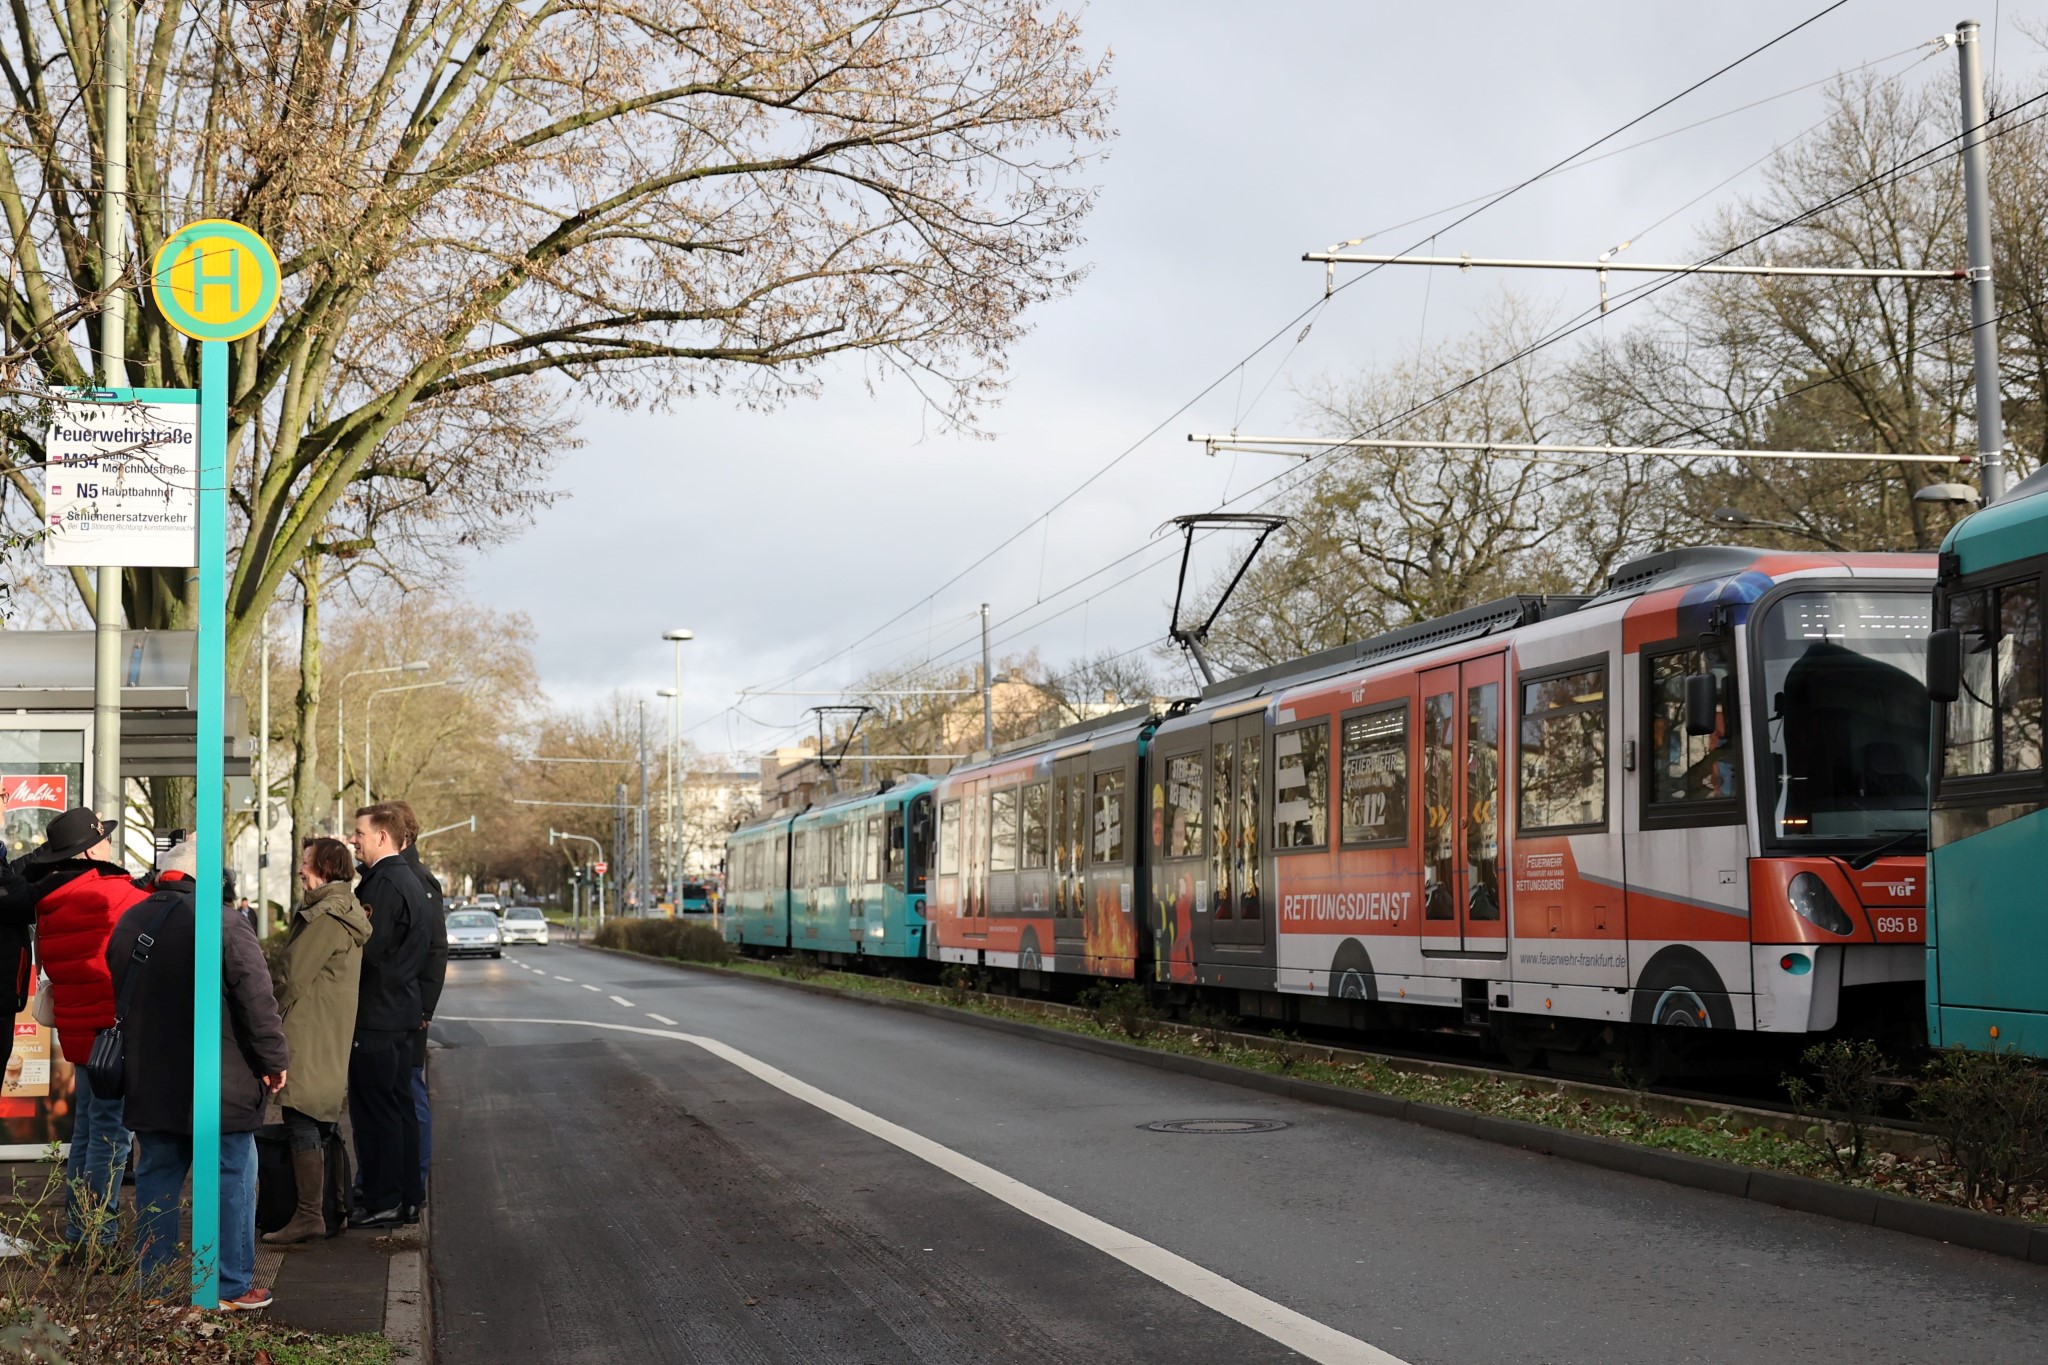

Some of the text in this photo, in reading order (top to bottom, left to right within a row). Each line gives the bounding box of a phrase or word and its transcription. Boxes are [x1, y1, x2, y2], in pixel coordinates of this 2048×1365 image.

[193, 248, 240, 312] H
[53, 426, 192, 444] Feuerwehrstraße
[63, 453, 99, 469] M34
[102, 463, 186, 474] Möchhofstraße
[76, 483, 98, 499] N5
[102, 486, 174, 498] Hauptbahnhof
[67, 510, 188, 523] Schienenersatzverkehr
[116, 523, 142, 531] Richtung
[1363, 792, 1386, 827] 112
[1527, 854, 1563, 868] FEUERWEHR
[1516, 878, 1565, 891] RETTUNGSDIENST
[1888, 878, 1916, 896] VGF
[1283, 892, 1412, 921] RETTUNGSDIENST
[1877, 917, 1918, 933] 695 B
[1520, 952, 1626, 968] www.feuerwehr-frankfurt.de
